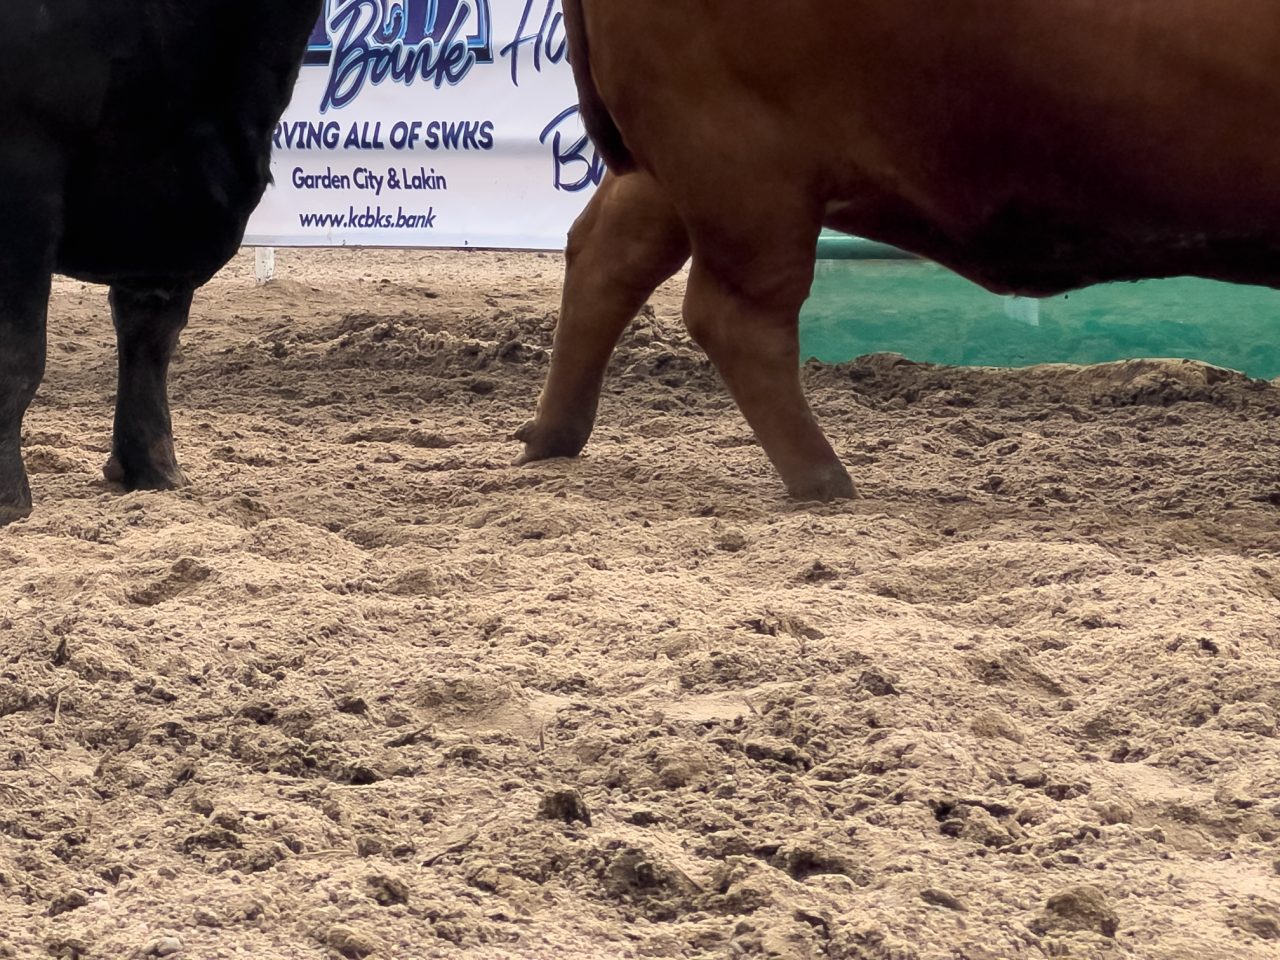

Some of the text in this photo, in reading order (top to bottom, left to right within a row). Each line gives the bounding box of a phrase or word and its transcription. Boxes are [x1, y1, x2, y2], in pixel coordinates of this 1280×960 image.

[272, 121, 494, 151] RVING ALL OF SWKS
[292, 166, 447, 195] Garden City & Lakin
[299, 206, 436, 228] www.kcbks.bank
